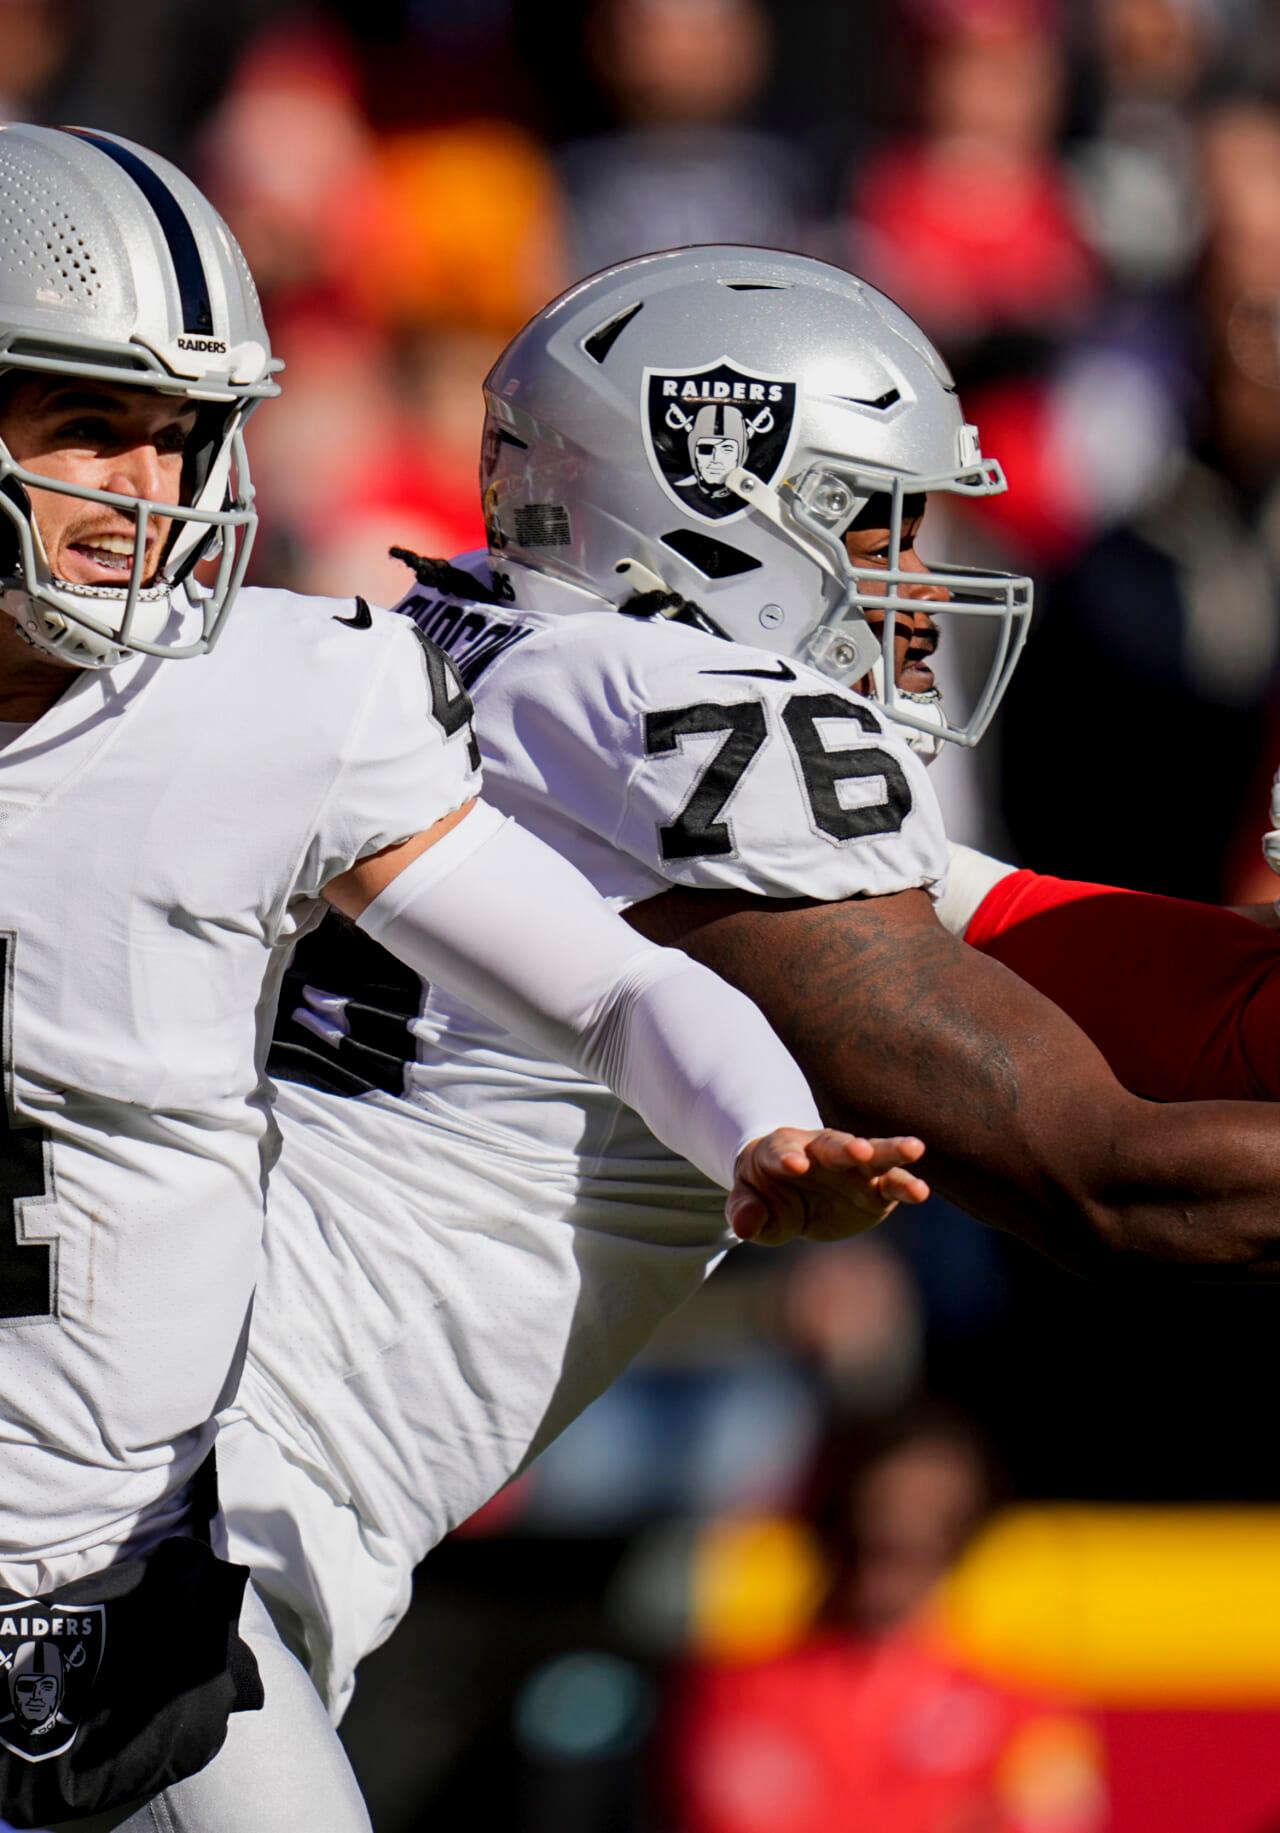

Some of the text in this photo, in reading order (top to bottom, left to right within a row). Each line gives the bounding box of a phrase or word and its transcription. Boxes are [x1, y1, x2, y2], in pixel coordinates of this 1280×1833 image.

[177, 338, 227, 354] RAIDERS
[662, 380, 784, 402] RAIDERS
[411, 626, 483, 782] 4
[640, 689, 917, 866] 76
